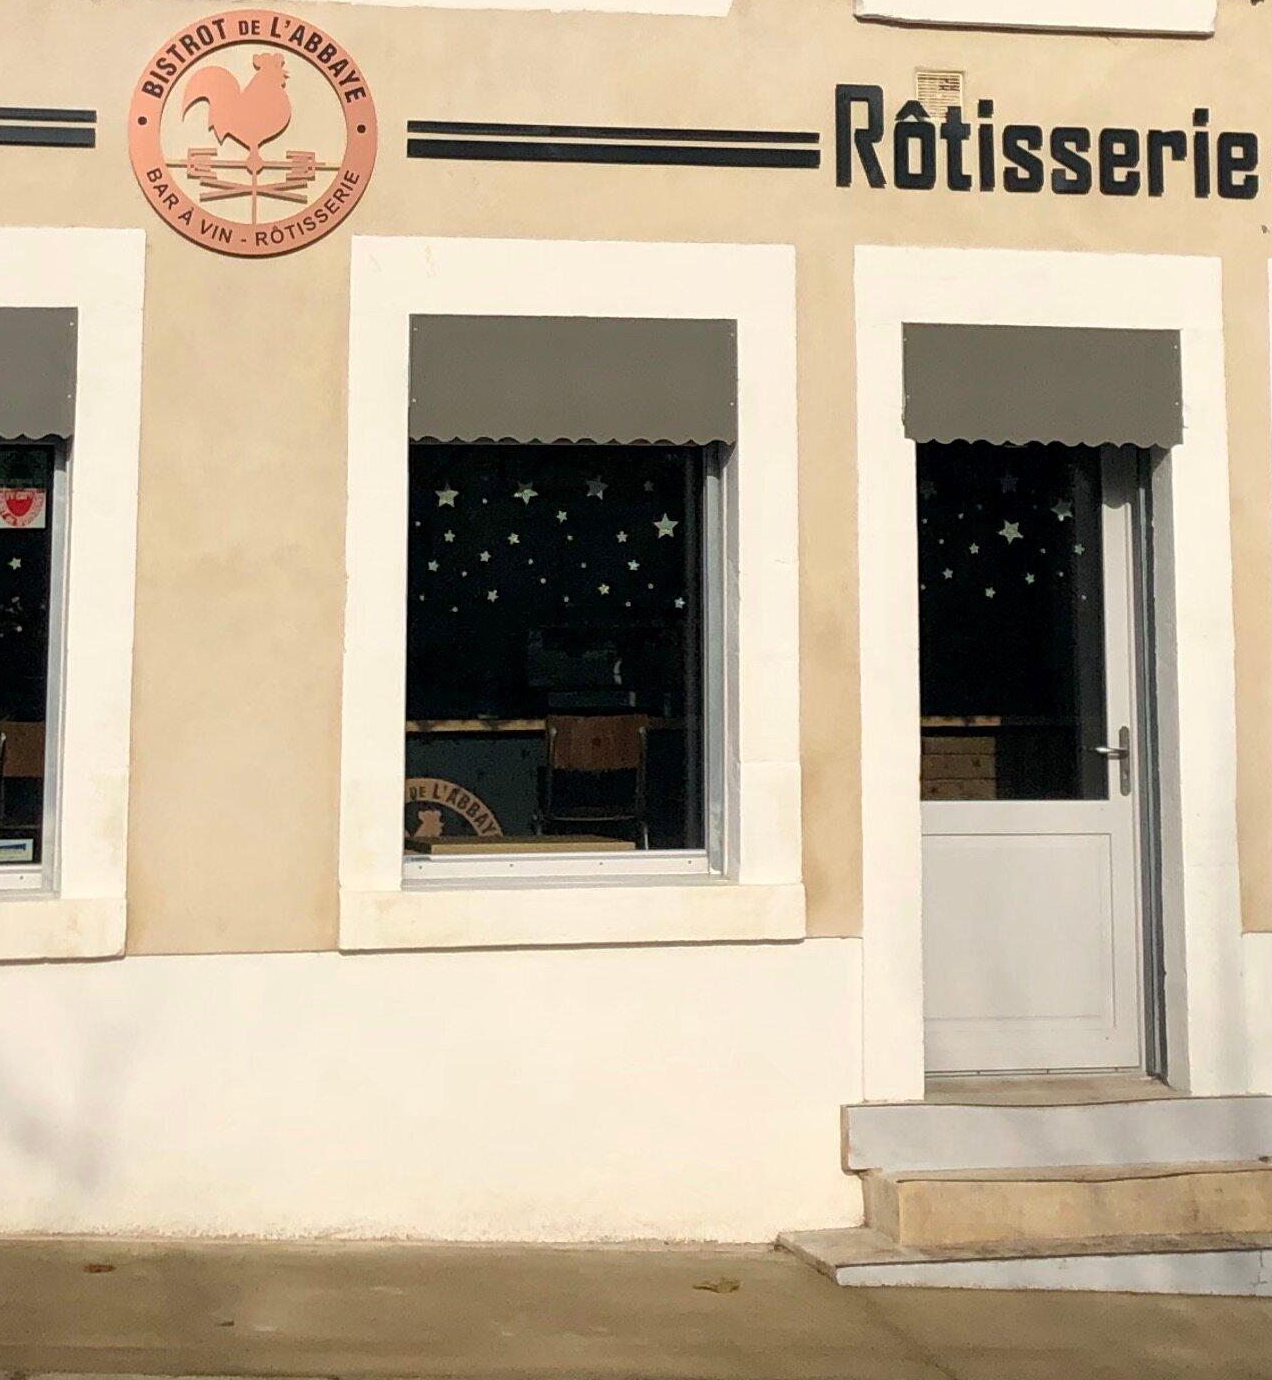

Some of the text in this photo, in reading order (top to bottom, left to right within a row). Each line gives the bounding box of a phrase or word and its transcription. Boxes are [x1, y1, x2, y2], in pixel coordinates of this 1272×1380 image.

[141, 17, 367, 104] BISTROT DE L'ABBAYE
[835, 83, 1259, 199] Rôtisserie
[146, 167, 180, 211] BAR
[178, 206, 195, 225] À
[200, 219, 233, 244] VIN
[256, 170, 361, 247] RÔTISSERIE
[409, 782, 500, 836] DE L'ABBAY
